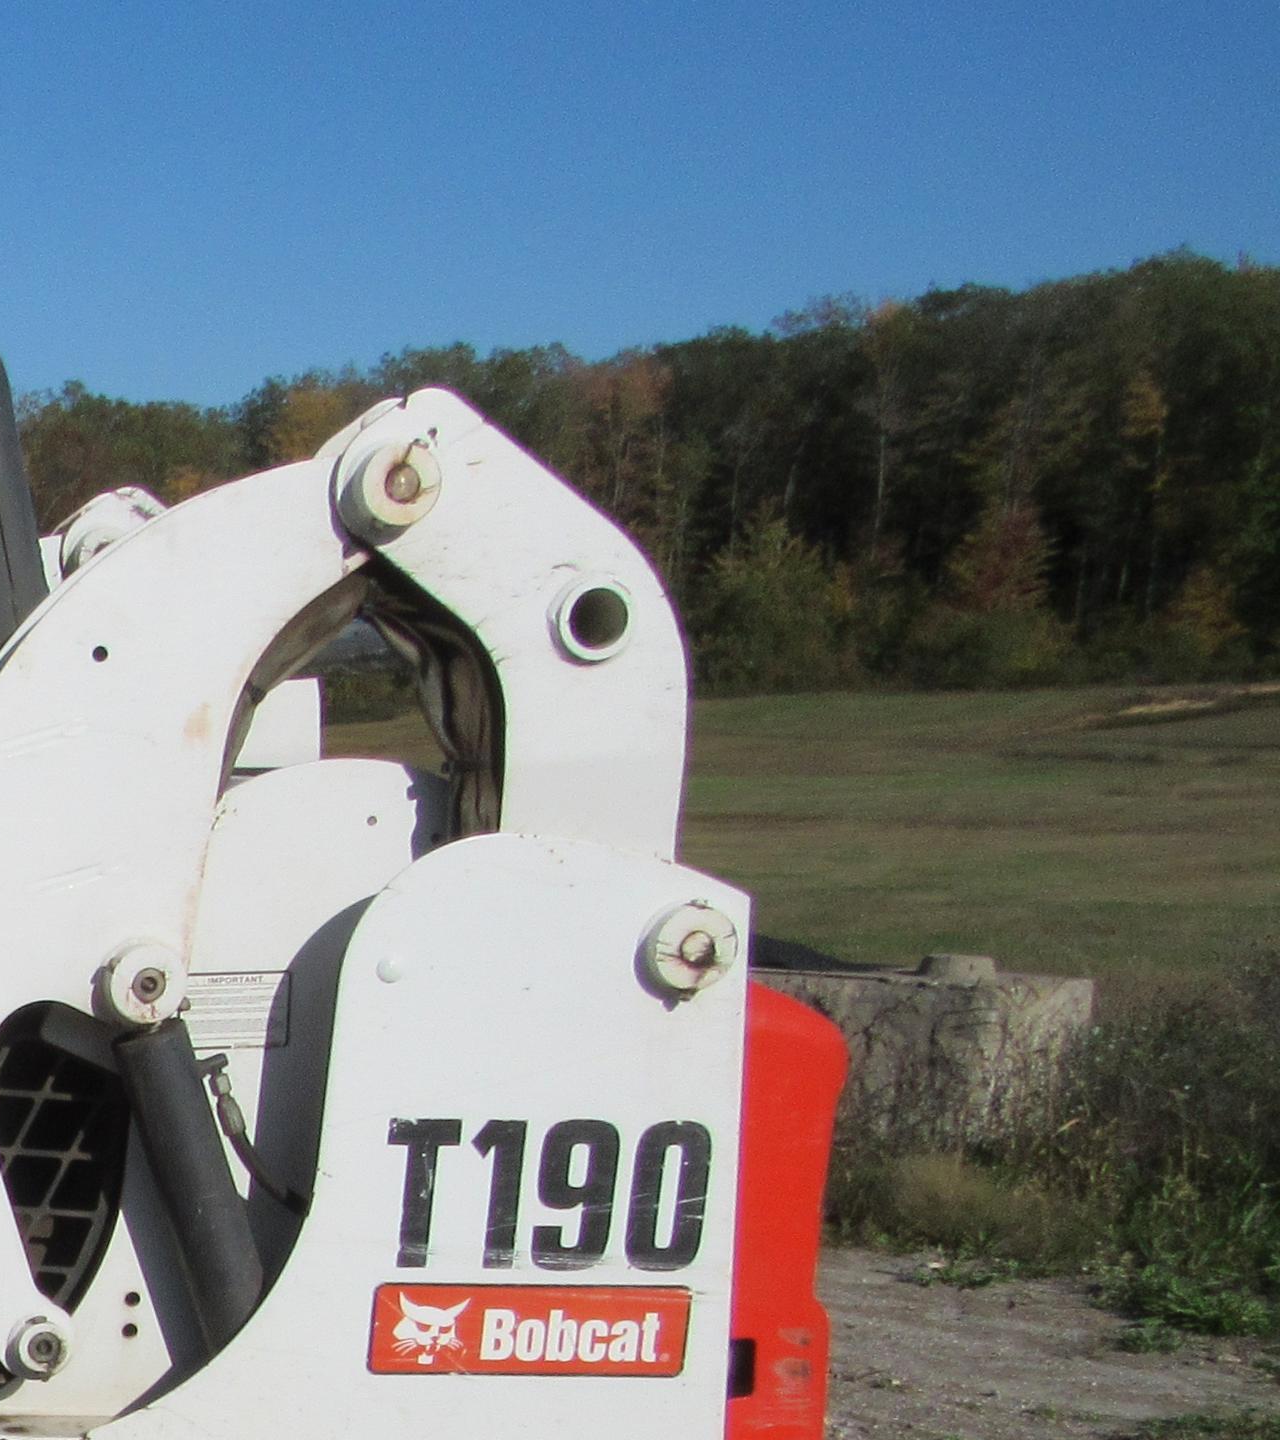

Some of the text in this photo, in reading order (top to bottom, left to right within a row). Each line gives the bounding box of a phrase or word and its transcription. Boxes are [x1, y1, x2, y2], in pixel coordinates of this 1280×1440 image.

[208, 975, 263, 984] IMPORTANT
[387, 1118, 712, 1271] T190
[479, 1308, 660, 1363] Bobcat
